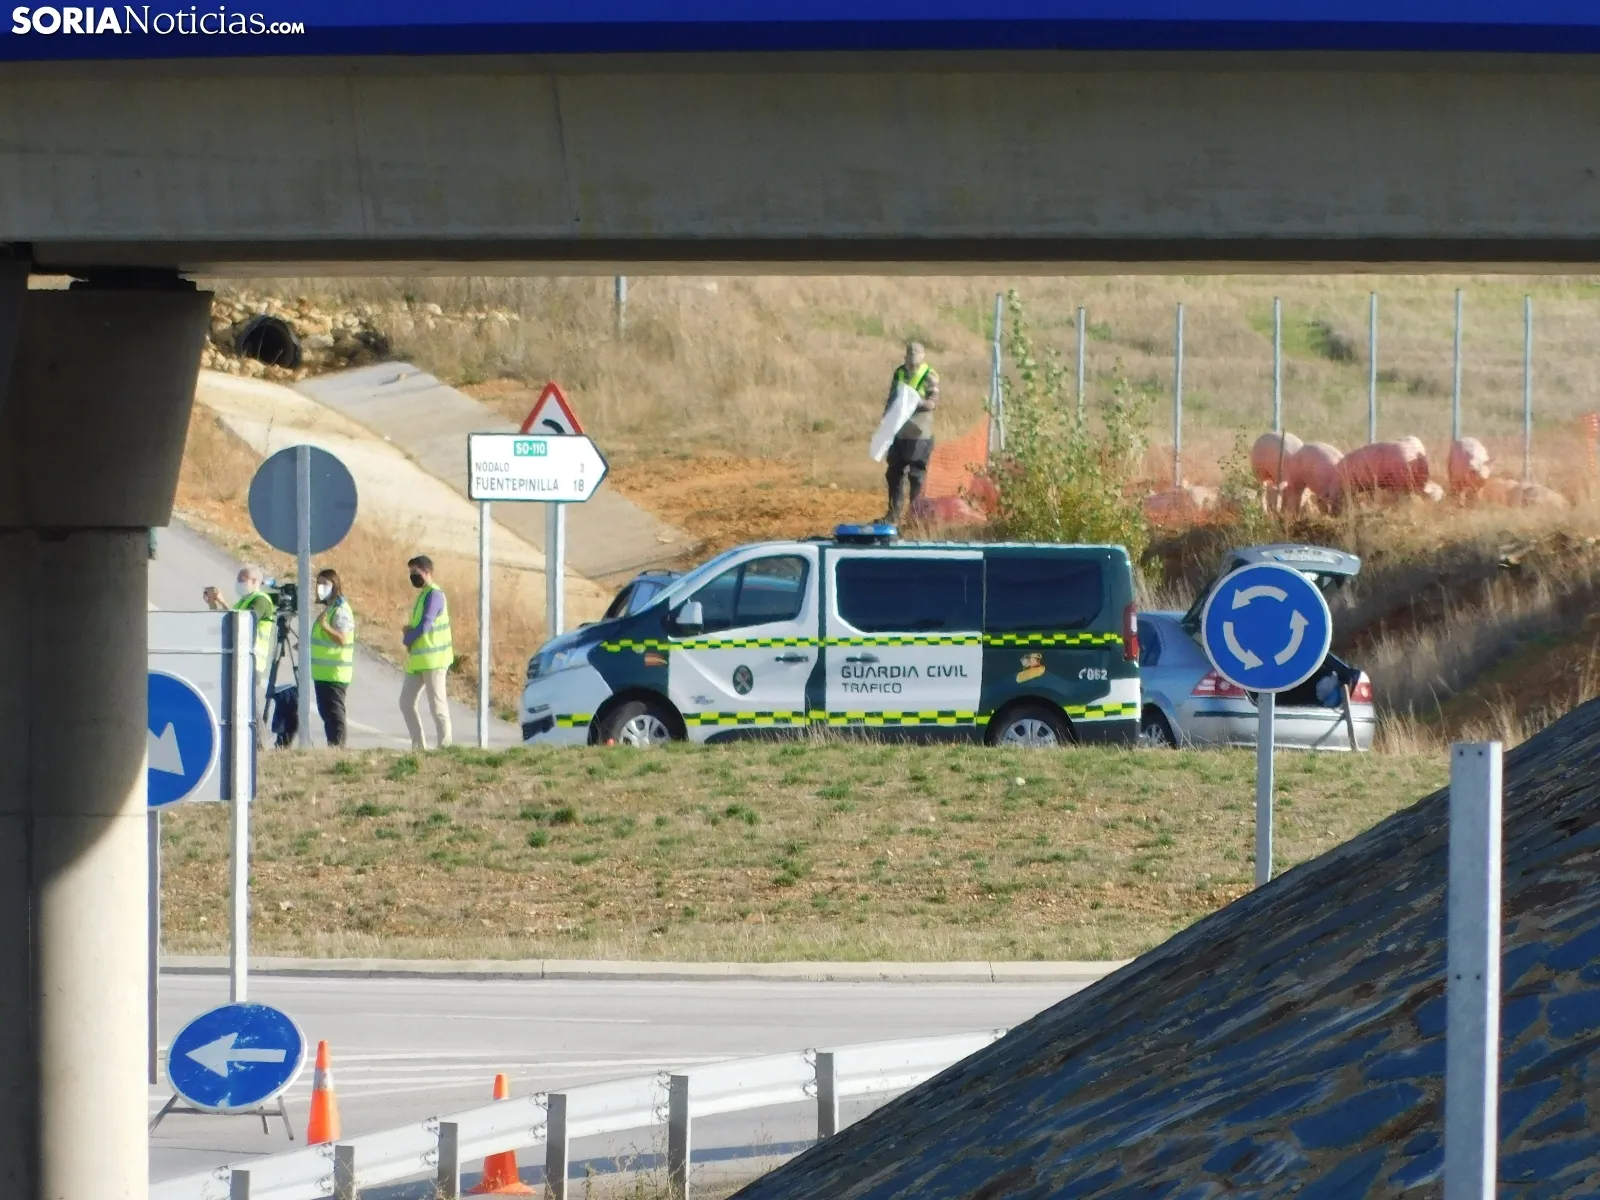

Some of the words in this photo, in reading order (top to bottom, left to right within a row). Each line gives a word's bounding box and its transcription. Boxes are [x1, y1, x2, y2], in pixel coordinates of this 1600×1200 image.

[515, 442, 545, 455] SO-110
[580, 463, 585, 473] 3
[476, 476, 559, 491] FUENTEPINILLA
[573, 480, 585, 492] 18
[841, 665, 919, 678] GUARDIA
[927, 665, 968, 677] CIVIL
[1087, 668, 1108, 681] 062
